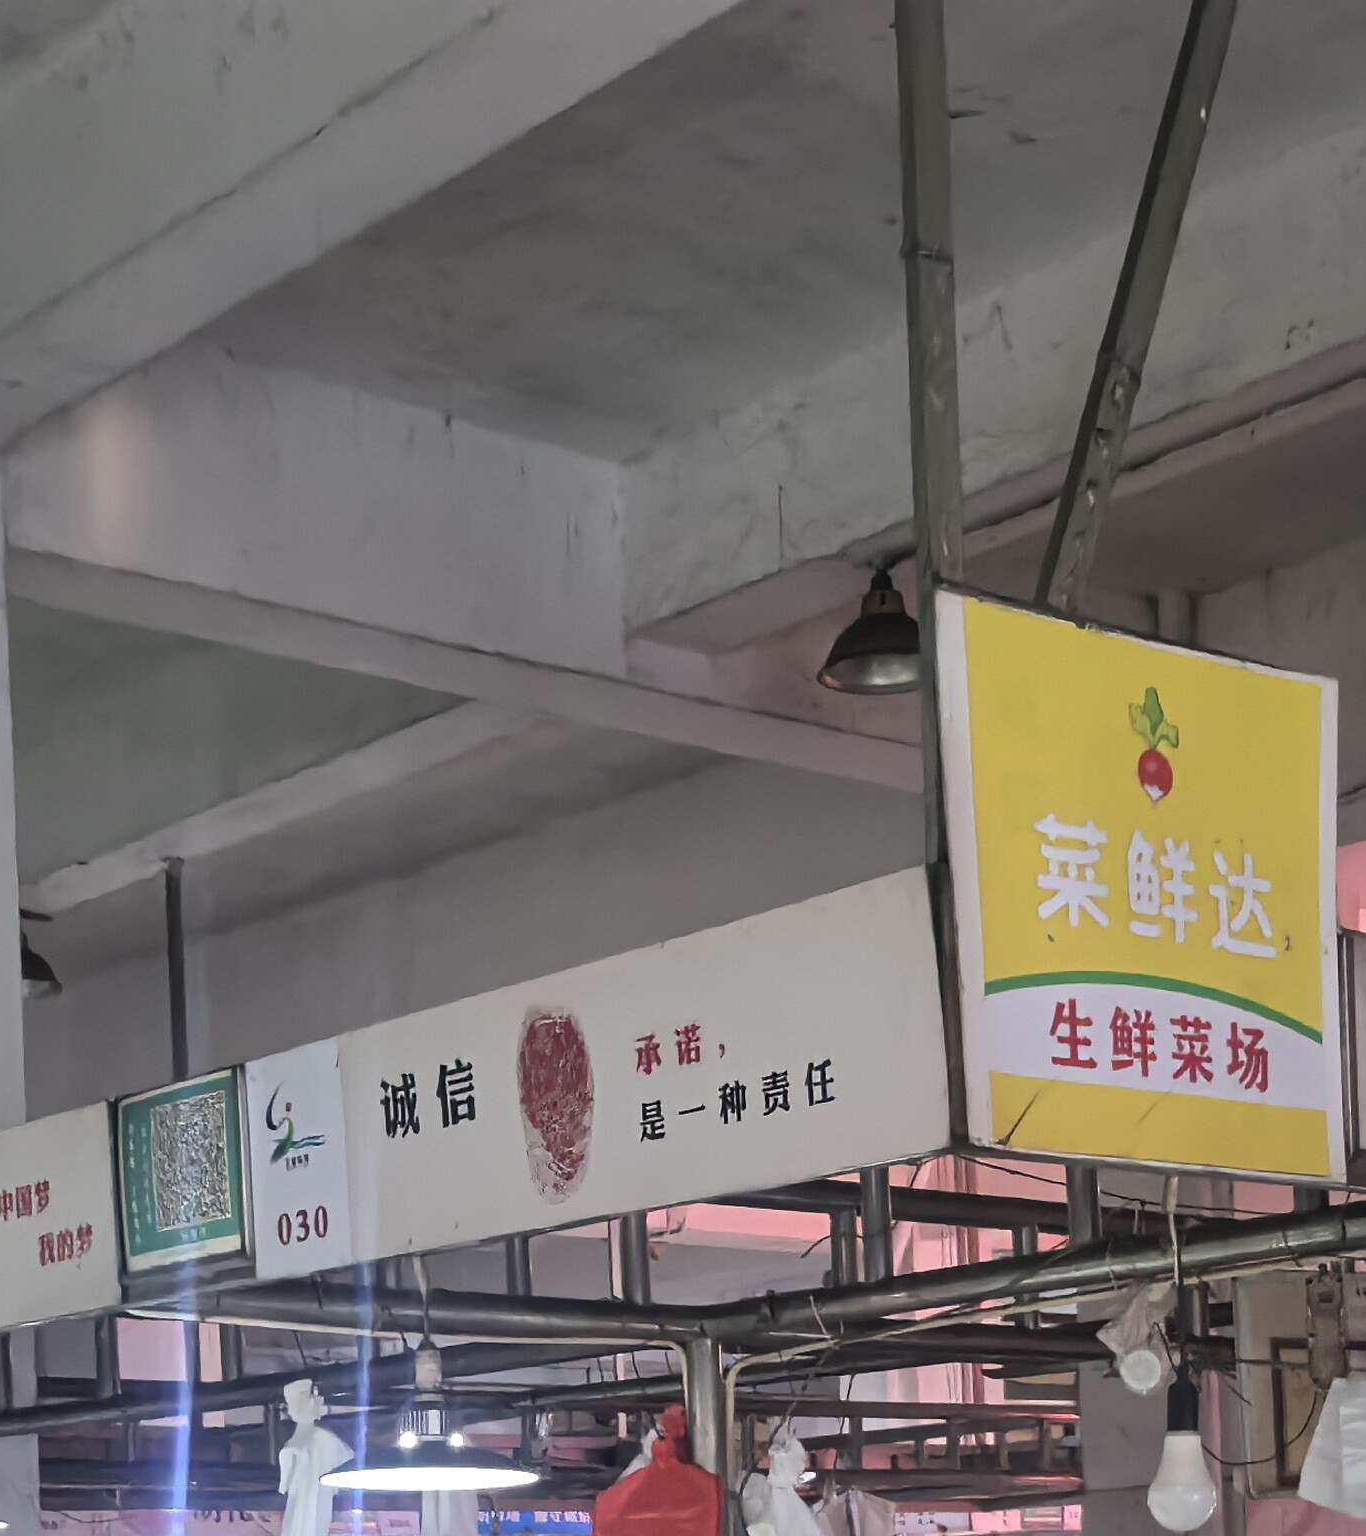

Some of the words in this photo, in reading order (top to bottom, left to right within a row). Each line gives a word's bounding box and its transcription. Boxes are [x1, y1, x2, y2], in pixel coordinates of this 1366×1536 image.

[1034, 813, 1277, 959] 菜鲜达
[1049, 997, 1270, 1094] 生鲜菜场
[379, 1058, 476, 1139] 诚信
[637, 1058, 837, 1142] 是一种责任
[37, 1221, 94, 1267] 我的梦
[277, 1205, 329, 1245] 030
